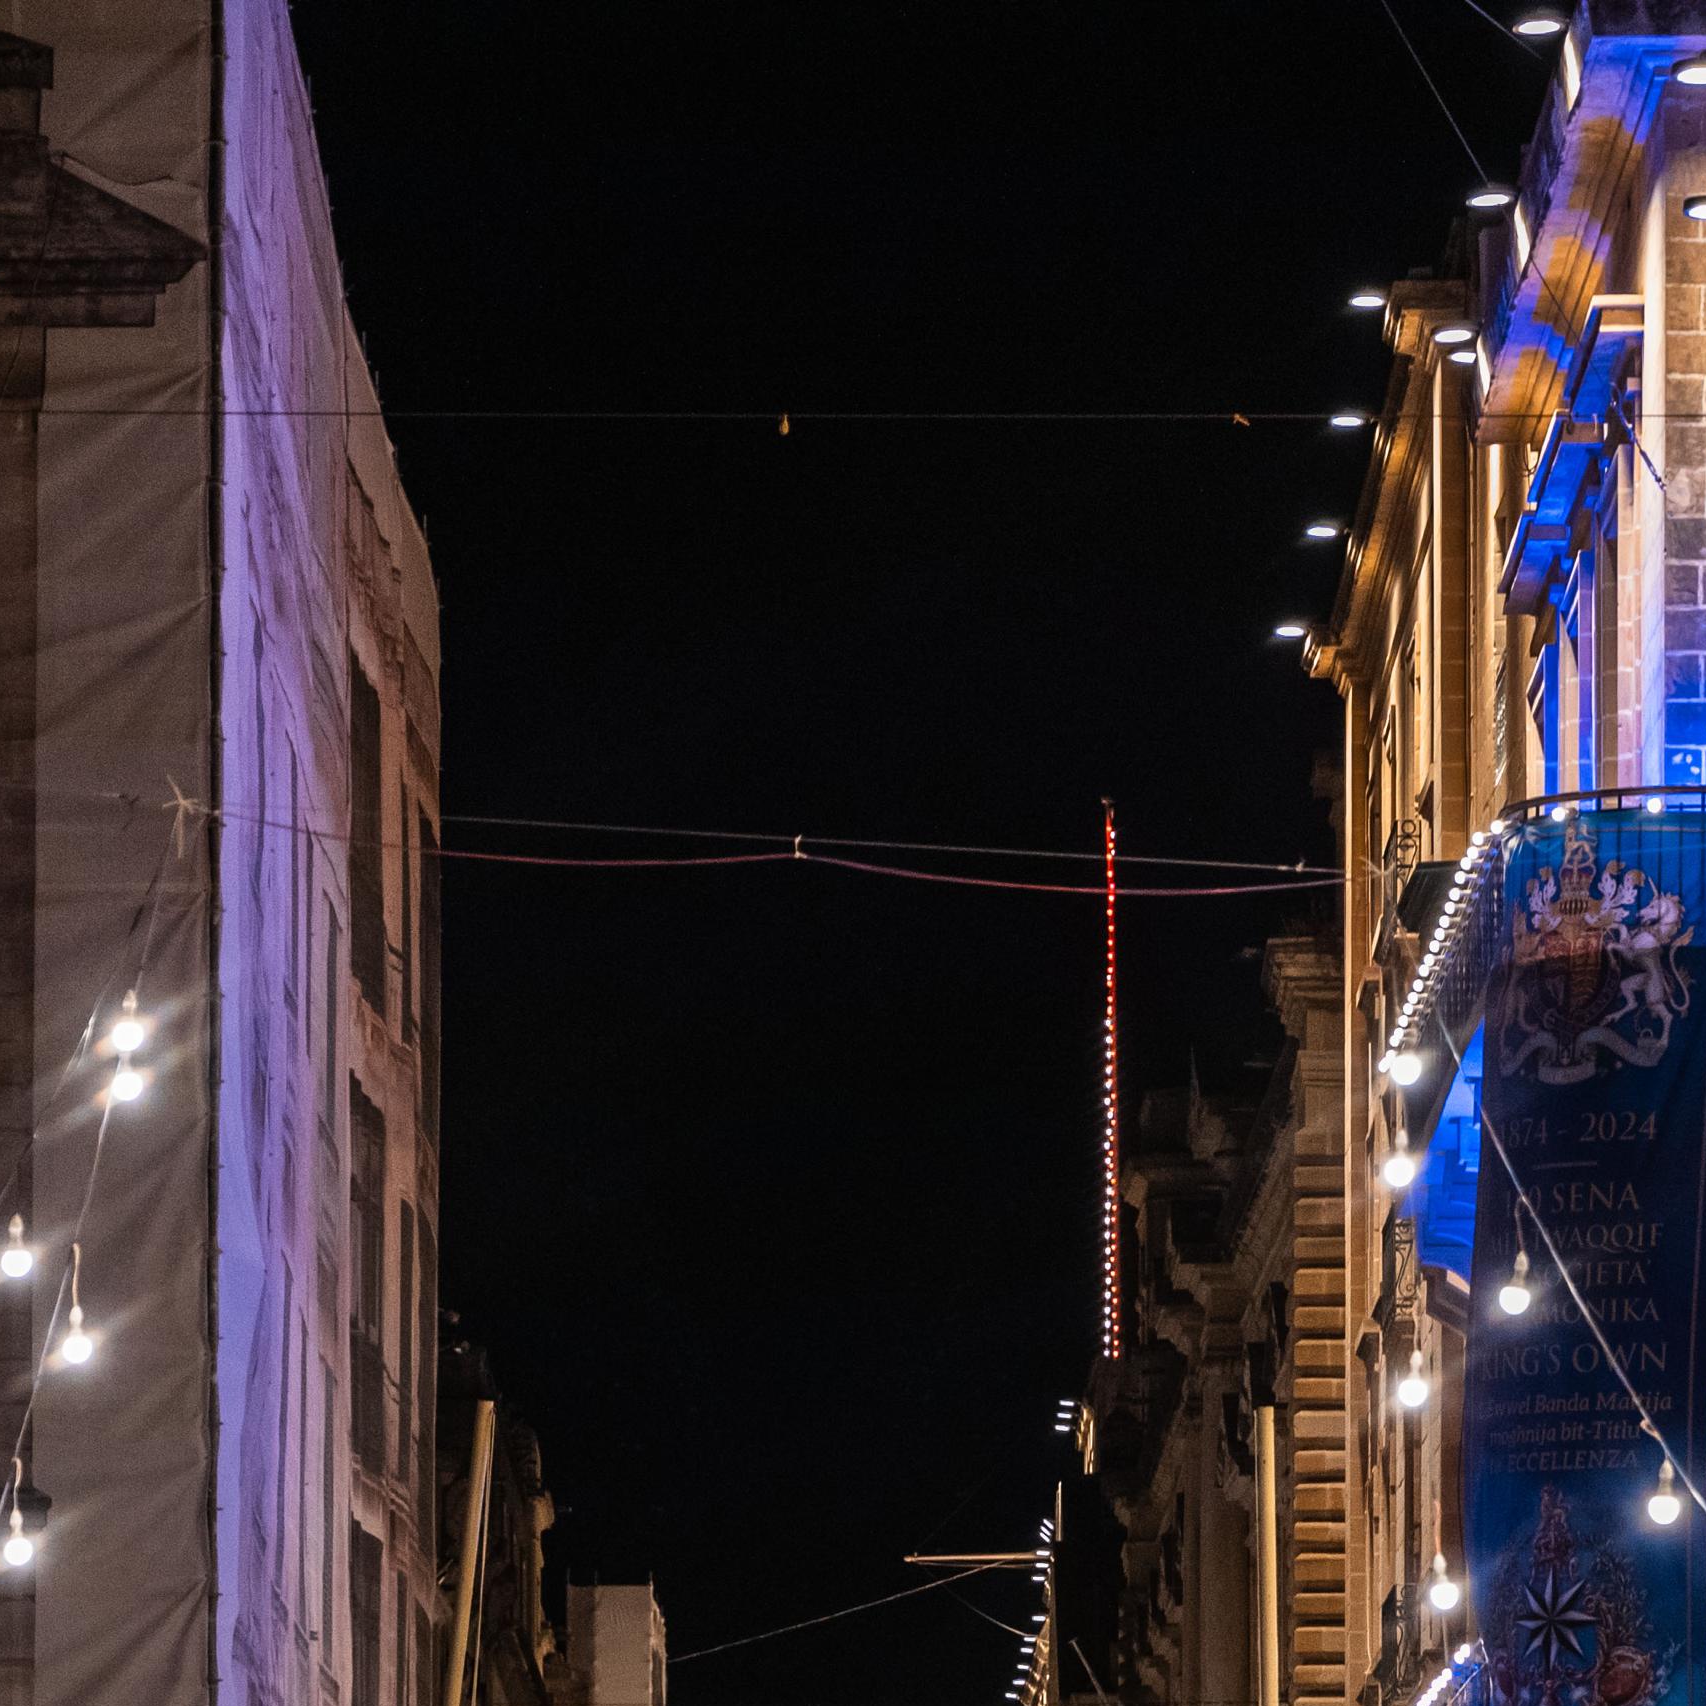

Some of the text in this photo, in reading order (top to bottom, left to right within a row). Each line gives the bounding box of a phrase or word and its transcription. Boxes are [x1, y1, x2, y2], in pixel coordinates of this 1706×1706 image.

[1501, 1117, 1549, 1149] 1874
[1579, 1110, 1658, 1142] 2024
[1505, 1181, 1641, 1217] 10 SENA
[1572, 1341, 1669, 1374] OWN
[1533, 1393, 1590, 1415] Banda
[1560, 1420, 1641, 1441] bit-Titlu
